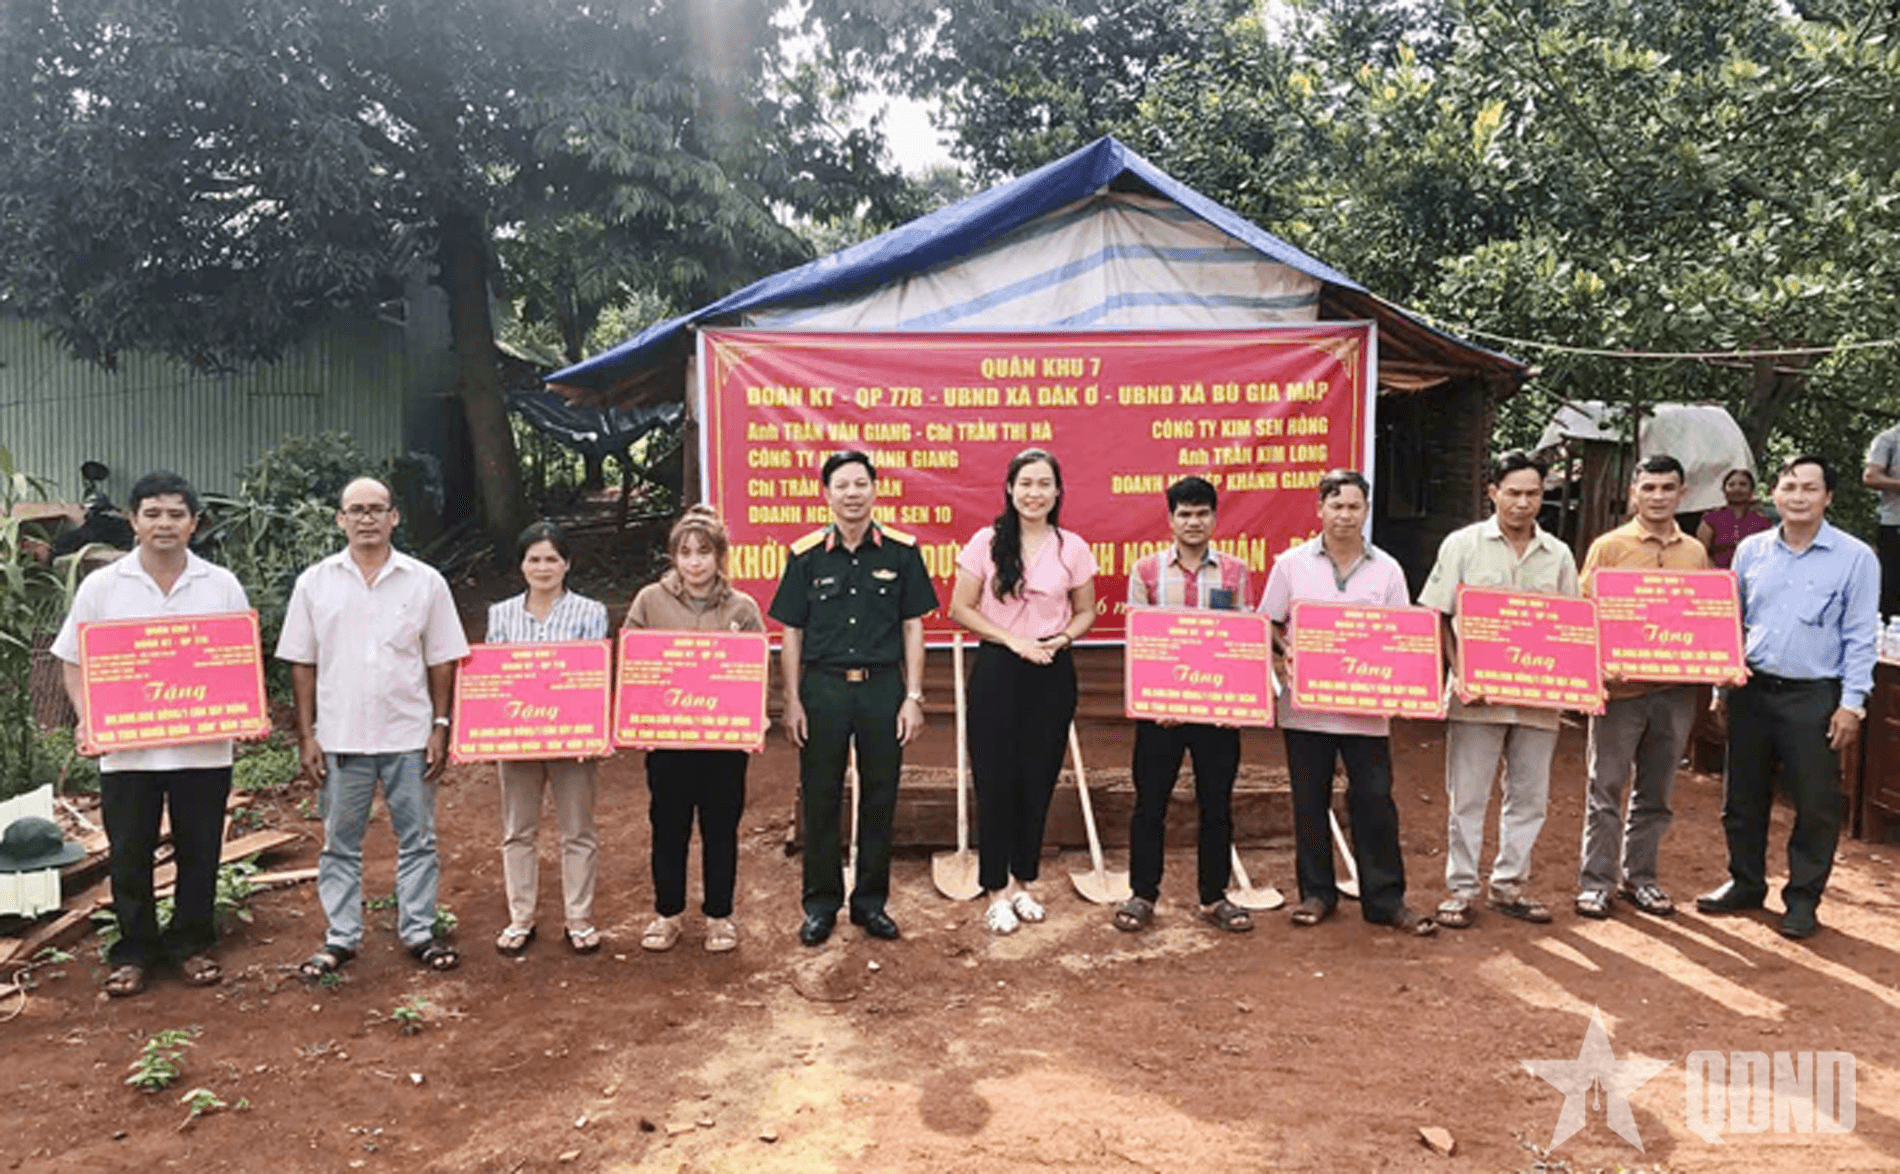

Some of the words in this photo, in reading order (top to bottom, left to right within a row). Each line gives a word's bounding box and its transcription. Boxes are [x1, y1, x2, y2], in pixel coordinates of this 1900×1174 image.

[981, 355, 1036, 380] QUÂN
[1042, 357, 1083, 377] KHU
[1090, 358, 1101, 377] 7
[809, 387, 834, 406] KT
[855, 387, 883, 408] QP
[889, 387, 922, 407] 778
[943, 386, 999, 407] UBND
[1118, 384, 1174, 405] UBND
[1246, 383, 1281, 403] GIA
[747, 421, 779, 441] Anh
[864, 422, 911, 441] GIANG
[1152, 417, 1194, 439] CÔNG
[1199, 418, 1217, 438] TY
[1221, 418, 1251, 438] KIM
[1254, 417, 1283, 436] SEN
[748, 447, 792, 468] CÔNG
[796, 450, 814, 468] TY
[912, 450, 958, 468] GIANG
[1179, 447, 1209, 466] Anh
[1289, 444, 1328, 463] LONG
[1112, 474, 1163, 494] DOANH
[1226, 470, 1277, 490] KHÁNH
[749, 506, 800, 524] DOANH
[901, 505, 929, 523] SEN
[935, 506, 951, 523] 10
[921, 539, 962, 586] DỰ
